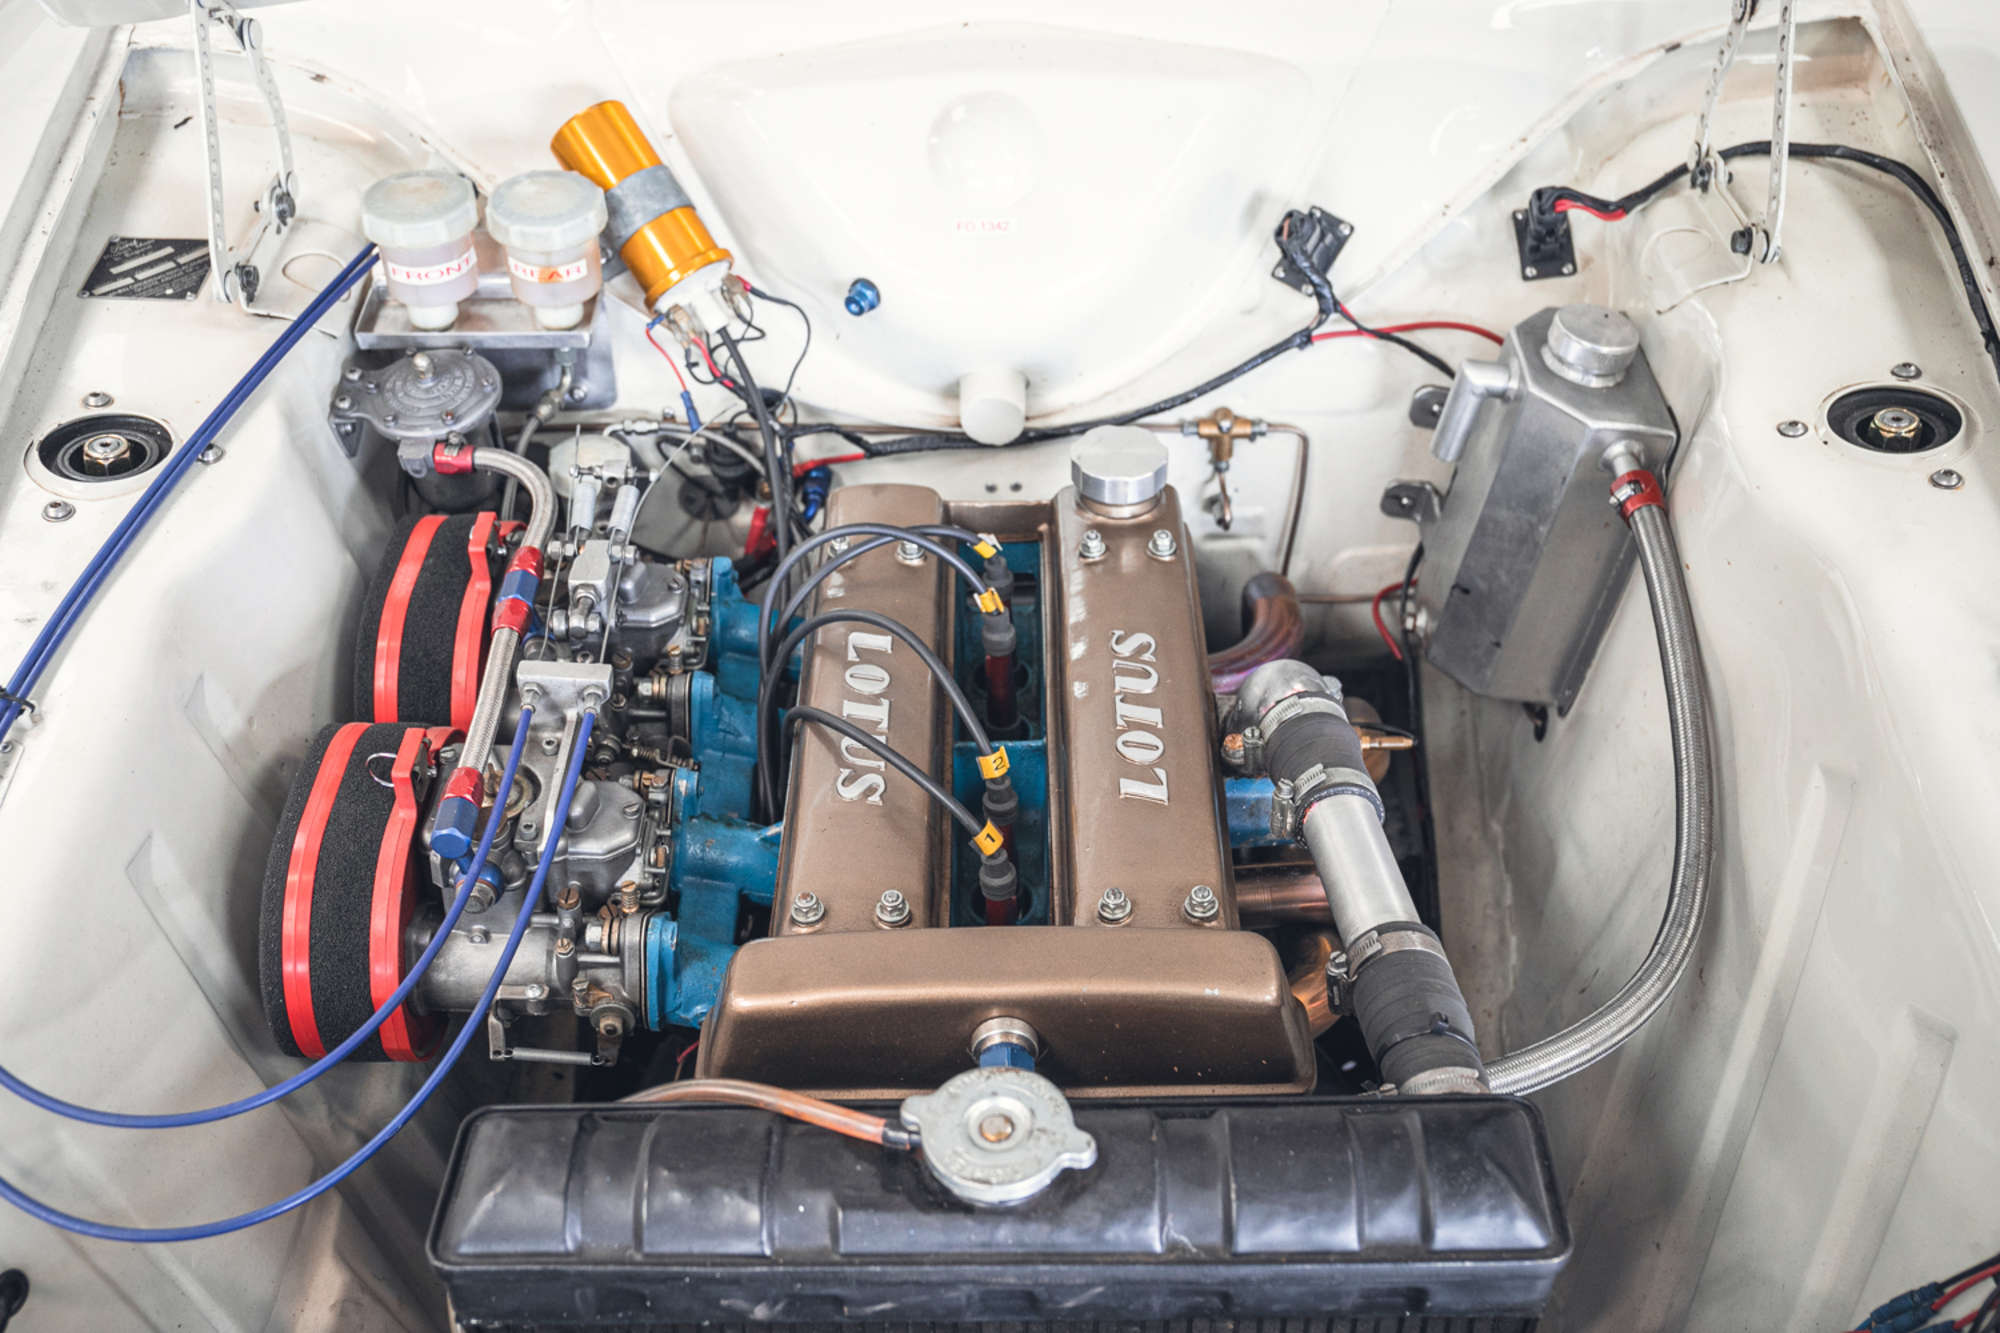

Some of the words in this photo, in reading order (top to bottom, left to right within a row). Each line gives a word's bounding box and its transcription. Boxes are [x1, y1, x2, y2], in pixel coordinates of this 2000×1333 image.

[390, 255, 472, 281] FRONT
[512, 262, 582, 282] REAR
[836, 631, 893, 806] LOTUS
[1110, 629, 1169, 806] LOTUS
[992, 756, 1006, 771] 2
[984, 833, 996, 843] 1
